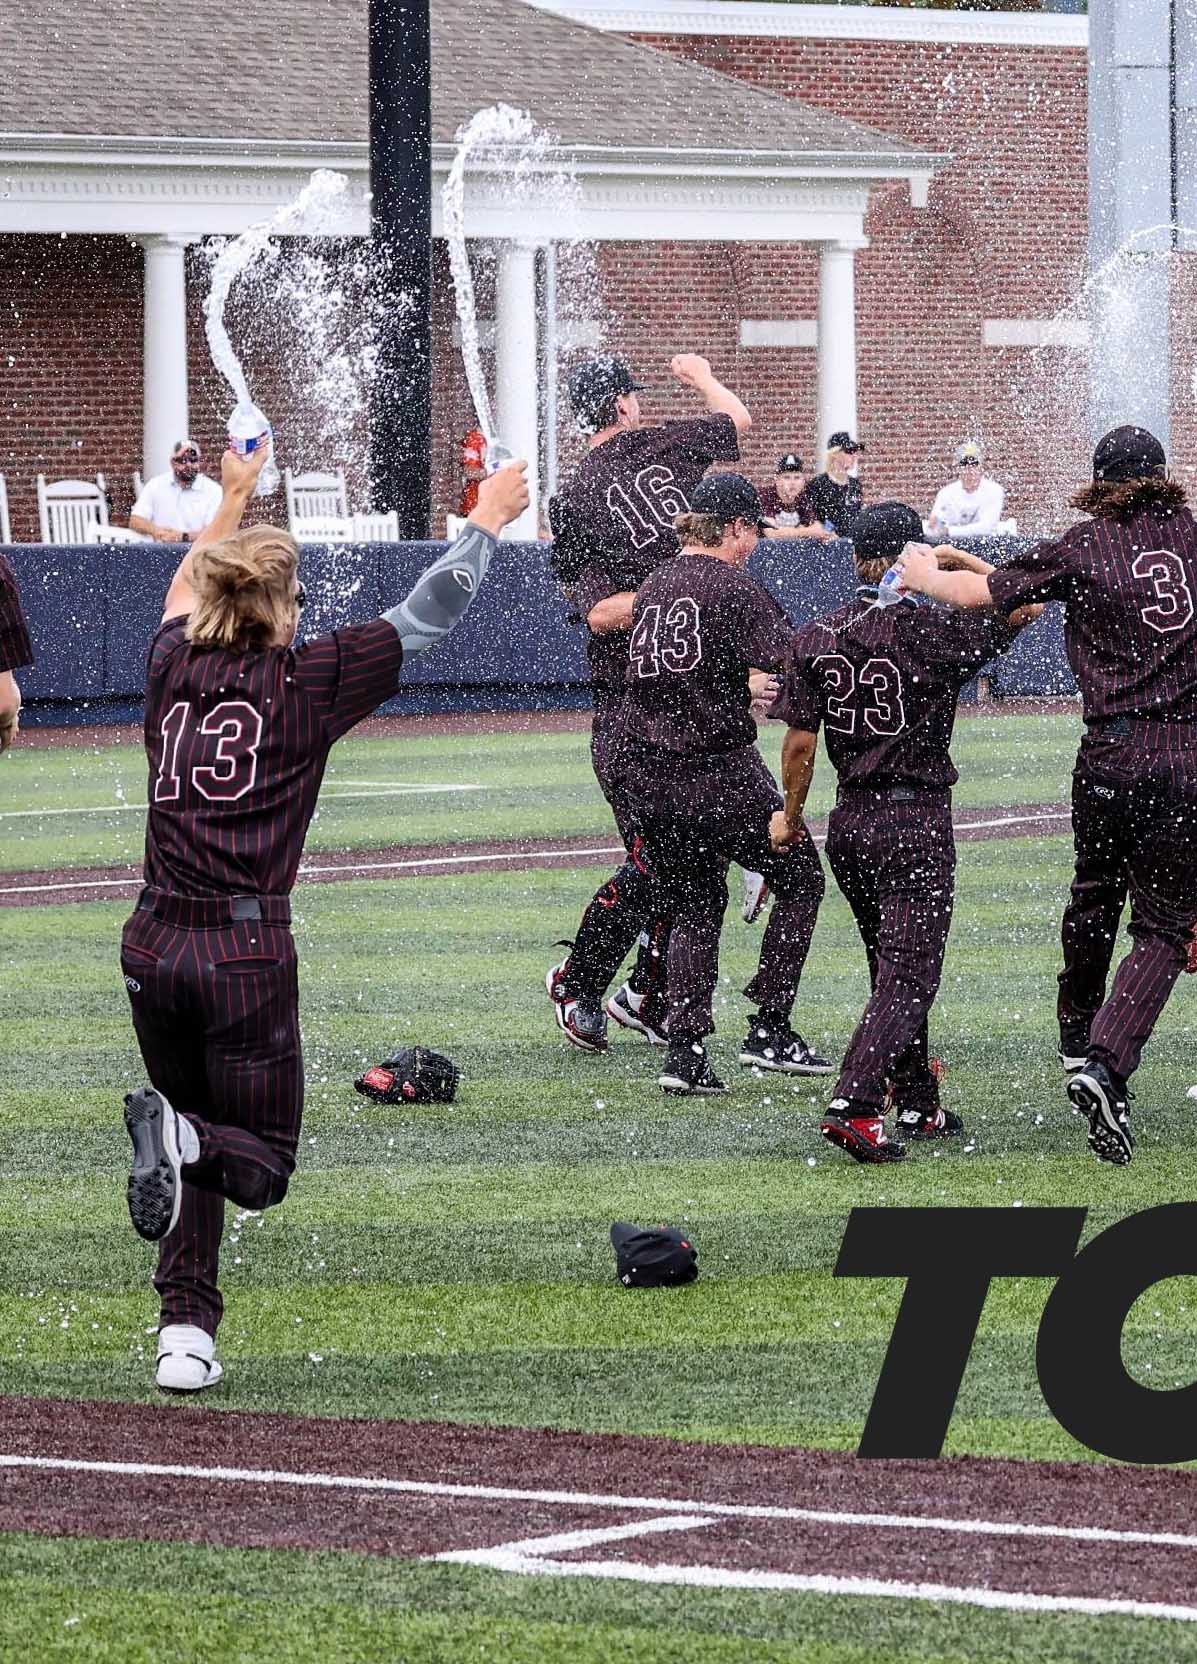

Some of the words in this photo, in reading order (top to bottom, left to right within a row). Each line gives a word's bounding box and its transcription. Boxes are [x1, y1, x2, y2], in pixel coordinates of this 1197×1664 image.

[606, 464, 692, 550] 16
[1131, 550, 1194, 633] 3
[629, 597, 702, 679] 43
[812, 654, 905, 736] 23
[154, 701, 263, 802] 13
